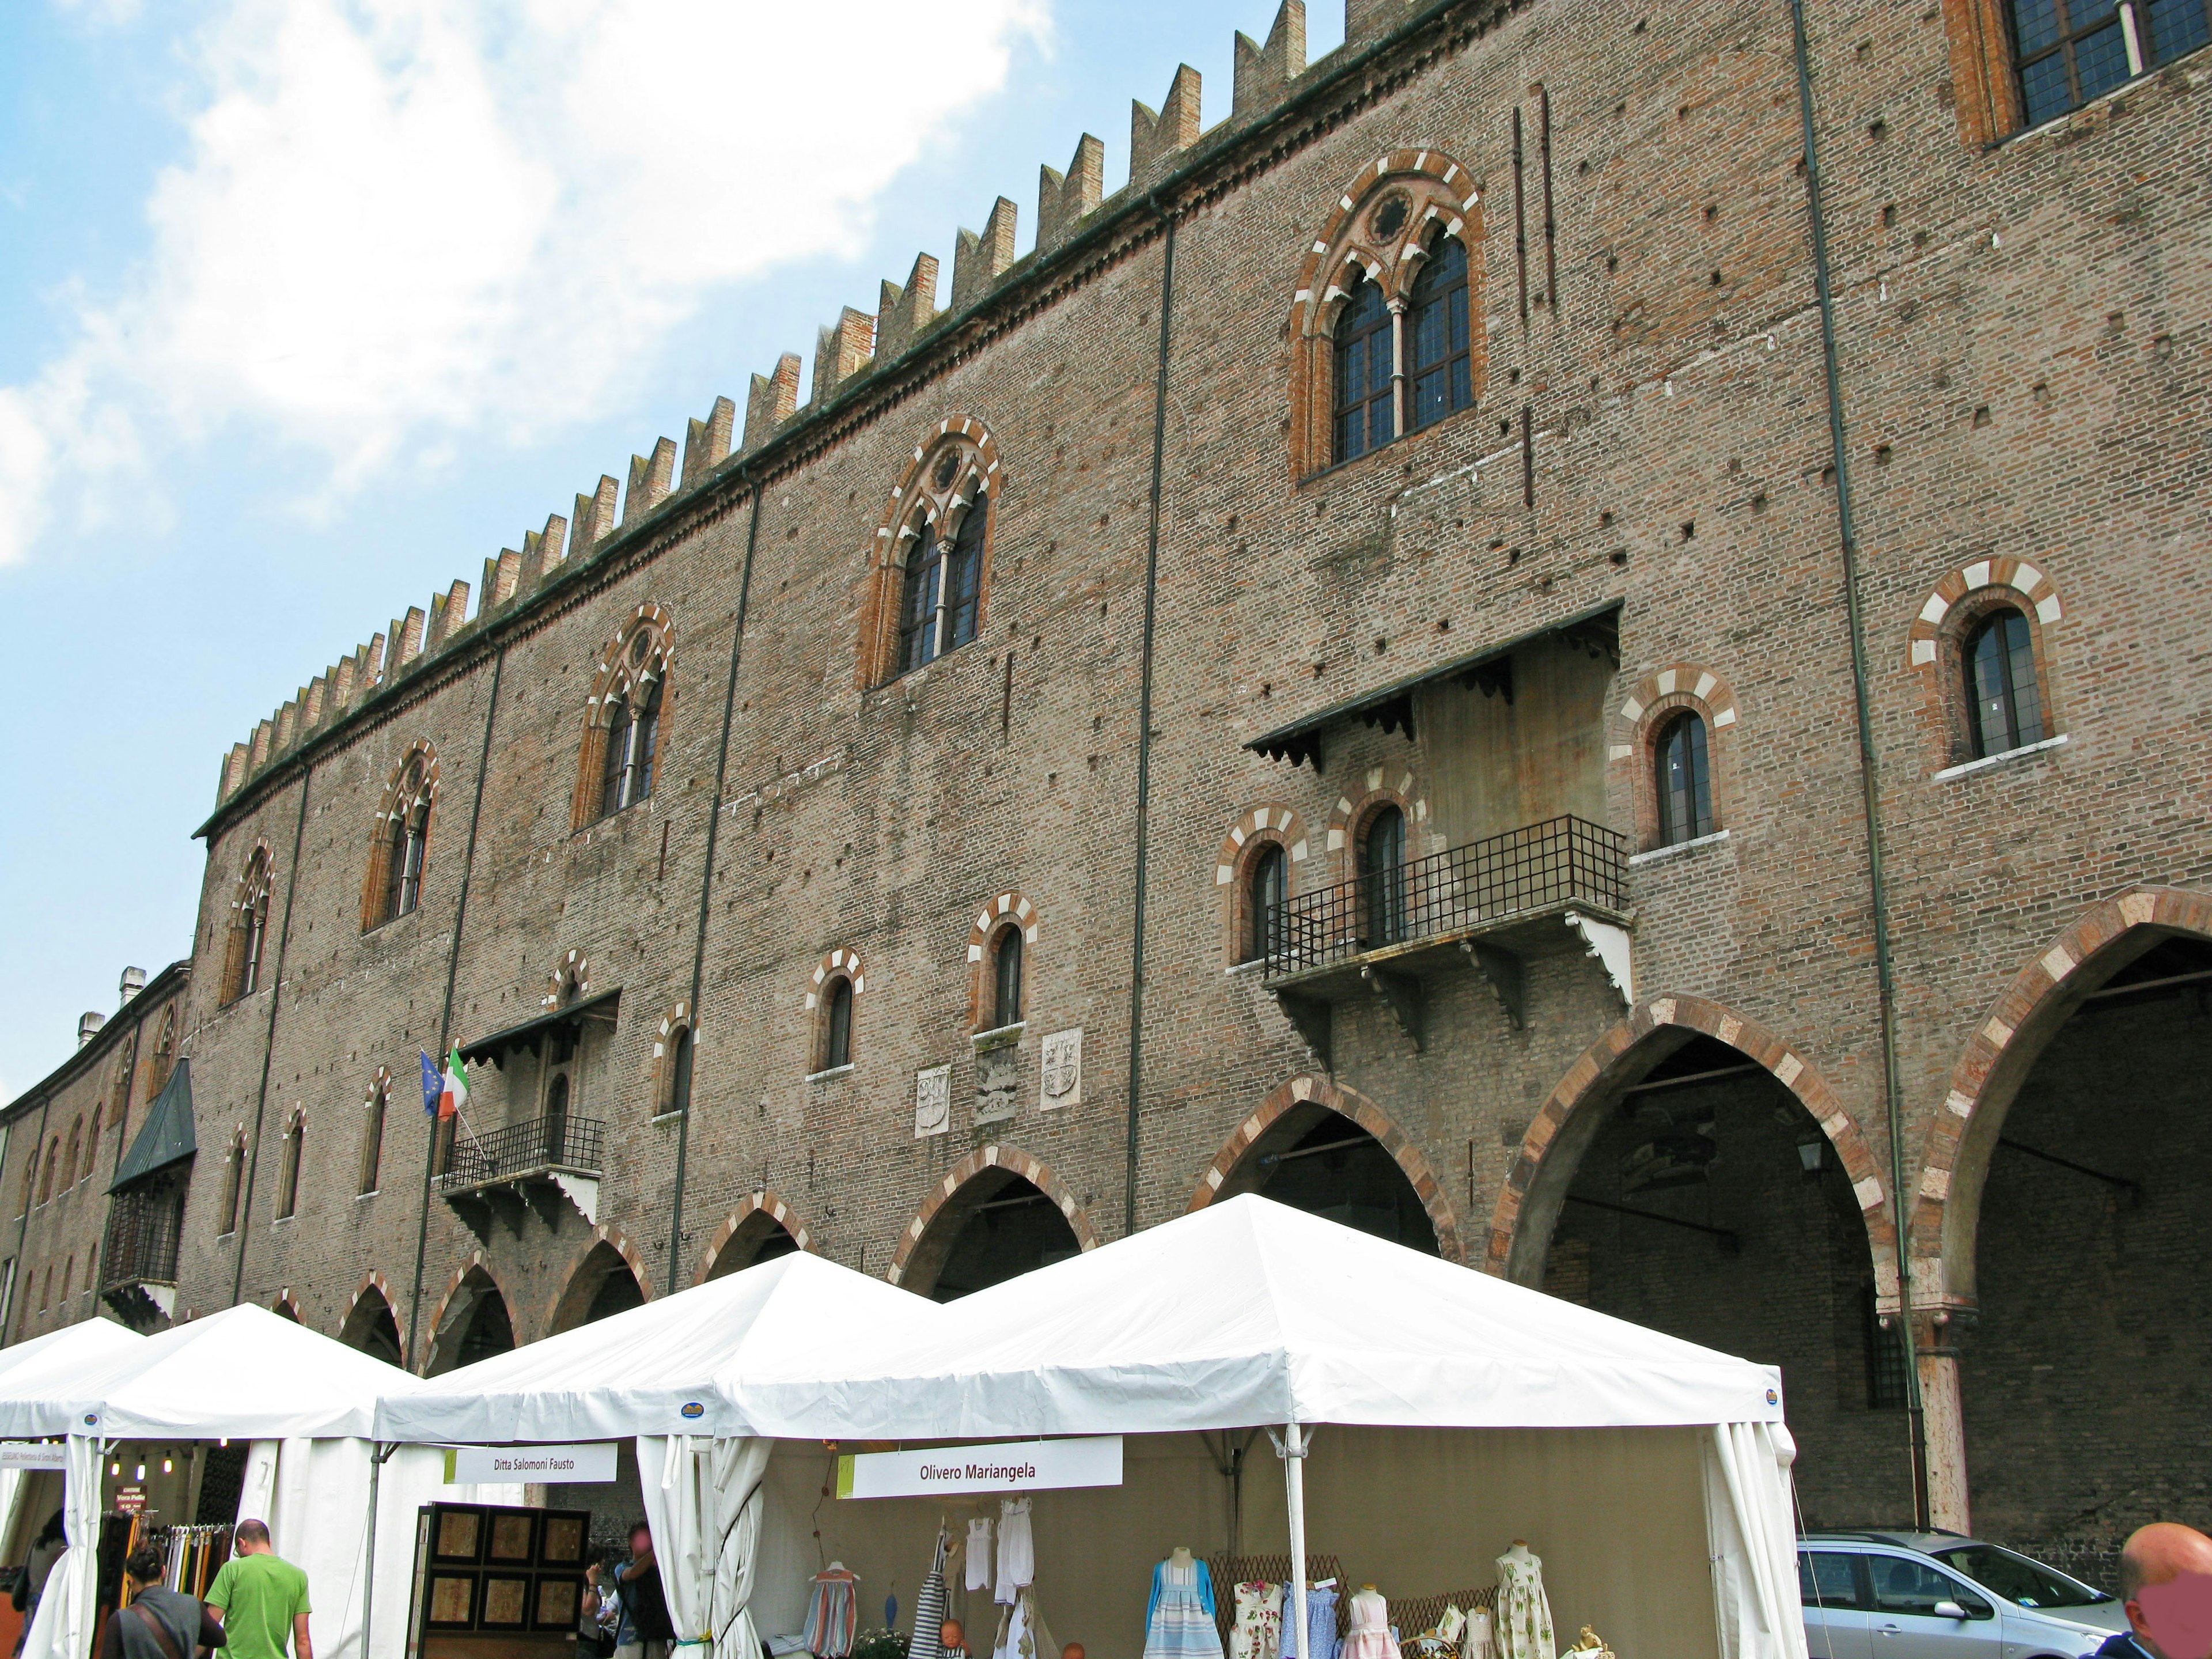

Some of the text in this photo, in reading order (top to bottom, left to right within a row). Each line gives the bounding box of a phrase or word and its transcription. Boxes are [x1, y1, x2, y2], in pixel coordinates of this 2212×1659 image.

[494, 1457, 574, 1470] Ditta Salomoni Fausto
[920, 1461, 1036, 1482] Olivero Mariangela
